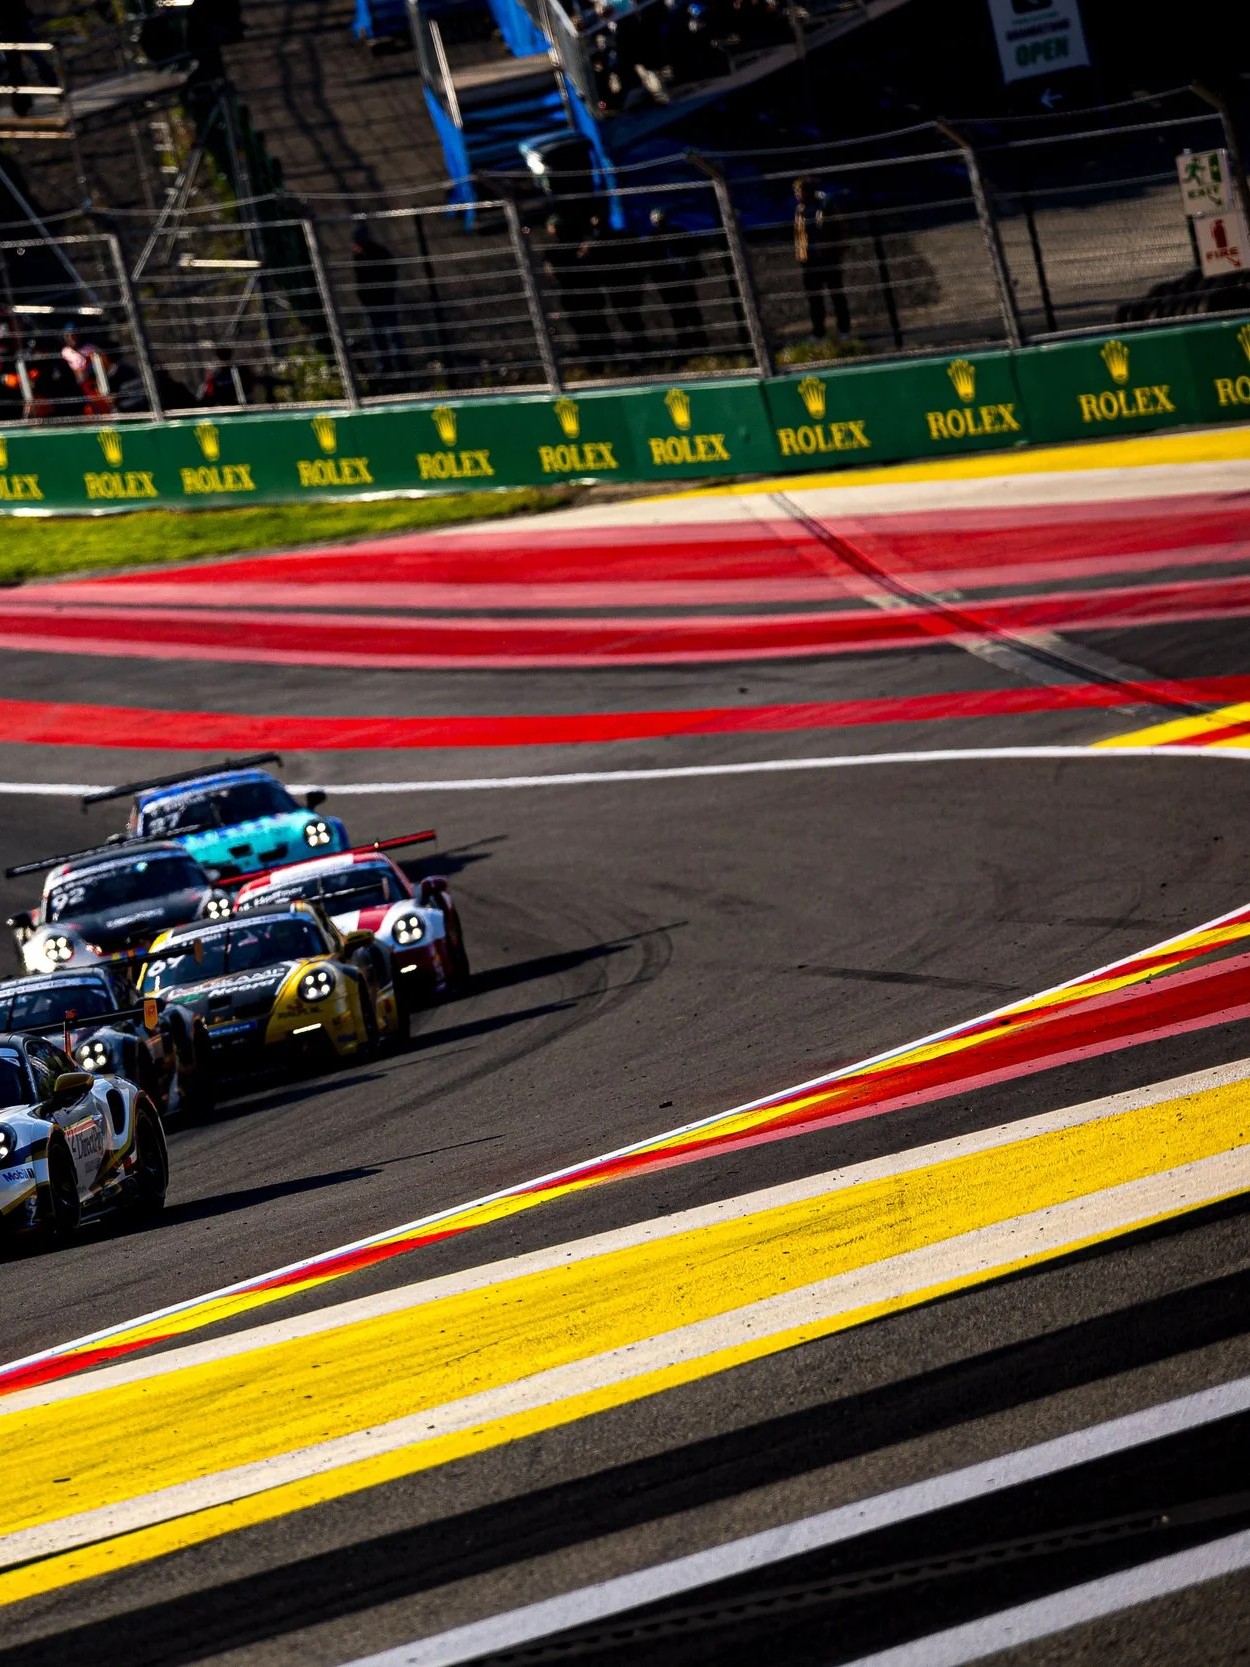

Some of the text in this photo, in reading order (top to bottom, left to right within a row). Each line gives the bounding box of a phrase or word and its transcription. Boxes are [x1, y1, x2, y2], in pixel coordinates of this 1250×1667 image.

[1016, 36, 1069, 66] OPEN
[1205, 246, 1239, 261] FIRE
[1079, 385, 1175, 422] ROLEX
[926, 403, 1020, 440] ROLEX
[649, 434, 730, 465] ROLEX
[777, 420, 871, 456] ROLEX
[297, 457, 373, 487] ROLEX
[417, 450, 494, 480] ROLEX
[538, 443, 618, 473] ROLEX
[84, 471, 159, 500] ROLEX
[180, 464, 256, 494] ROLEX
[2, 1169, 28, 1183] Mobil
